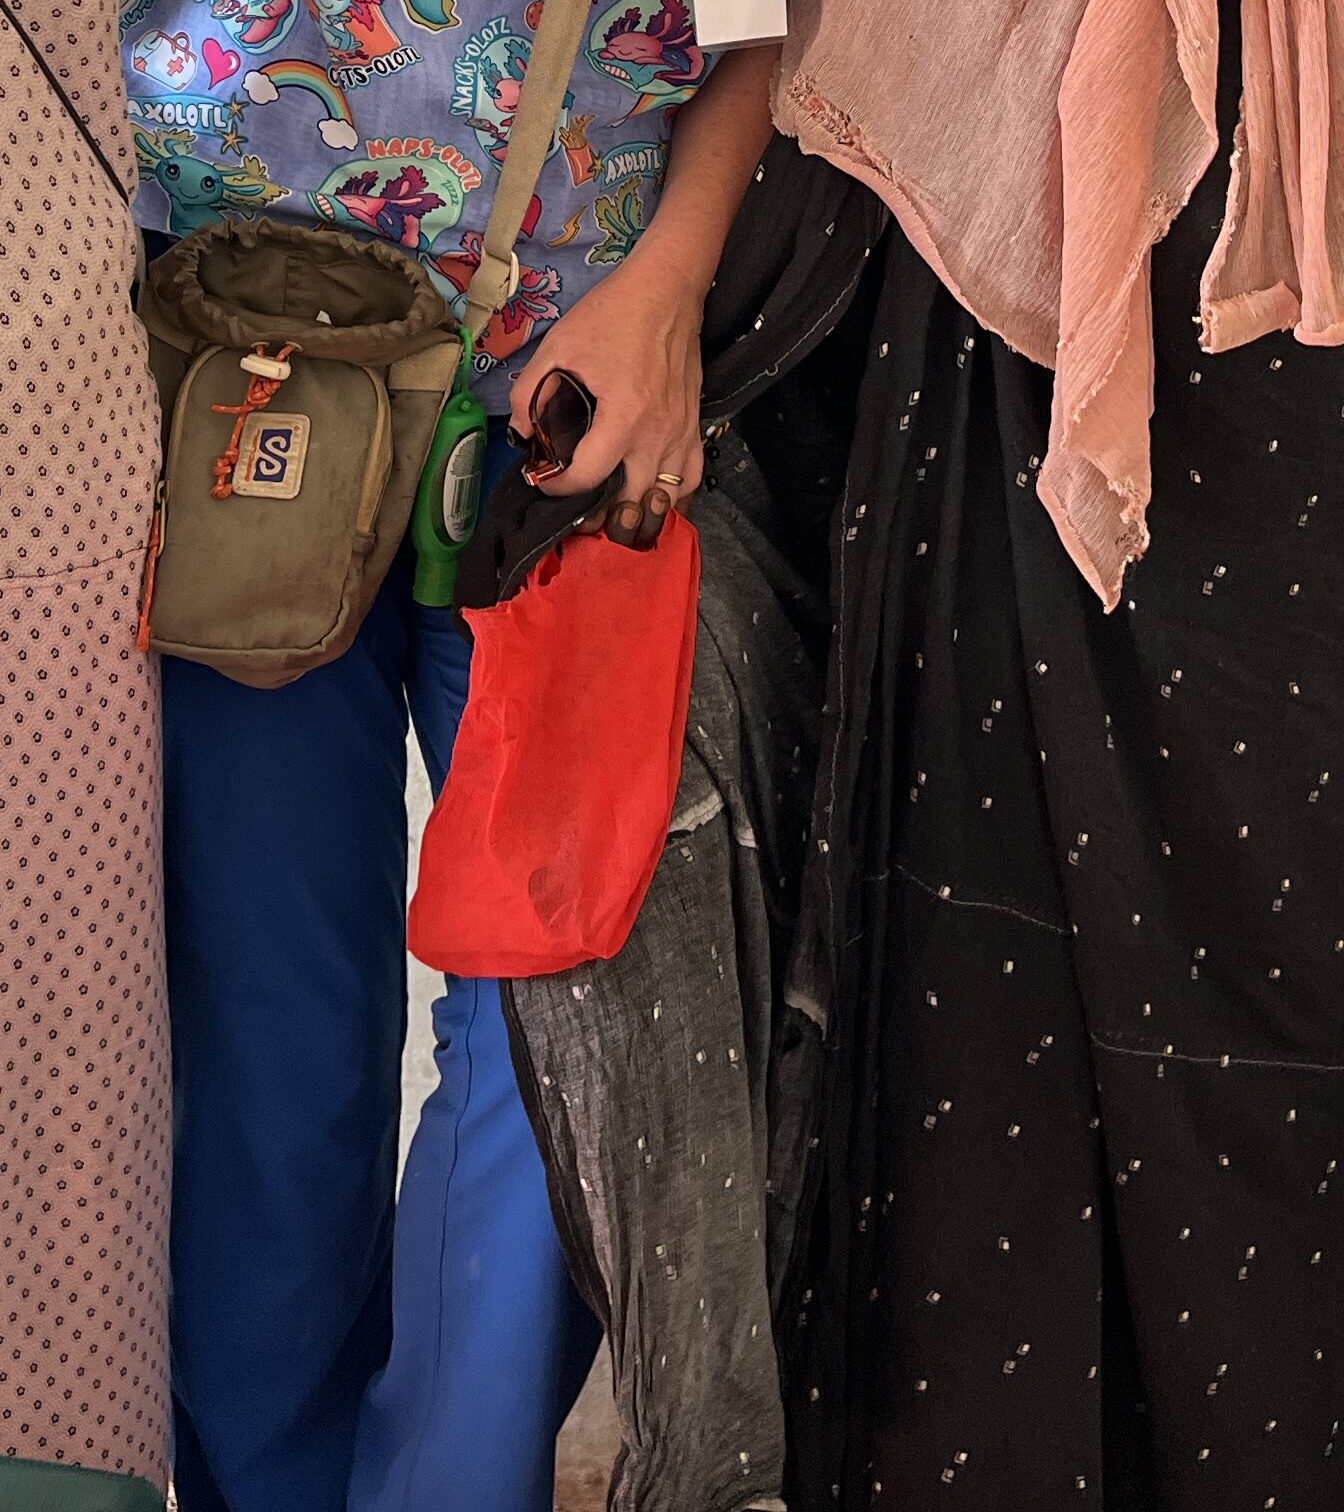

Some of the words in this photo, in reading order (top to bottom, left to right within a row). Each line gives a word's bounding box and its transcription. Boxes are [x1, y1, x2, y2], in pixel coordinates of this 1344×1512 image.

[128, 100, 227, 127] AXOLOTL
[366, 137, 483, 192] NAPS-OLOTL
[604, 148, 661, 184] AXOLOTL
